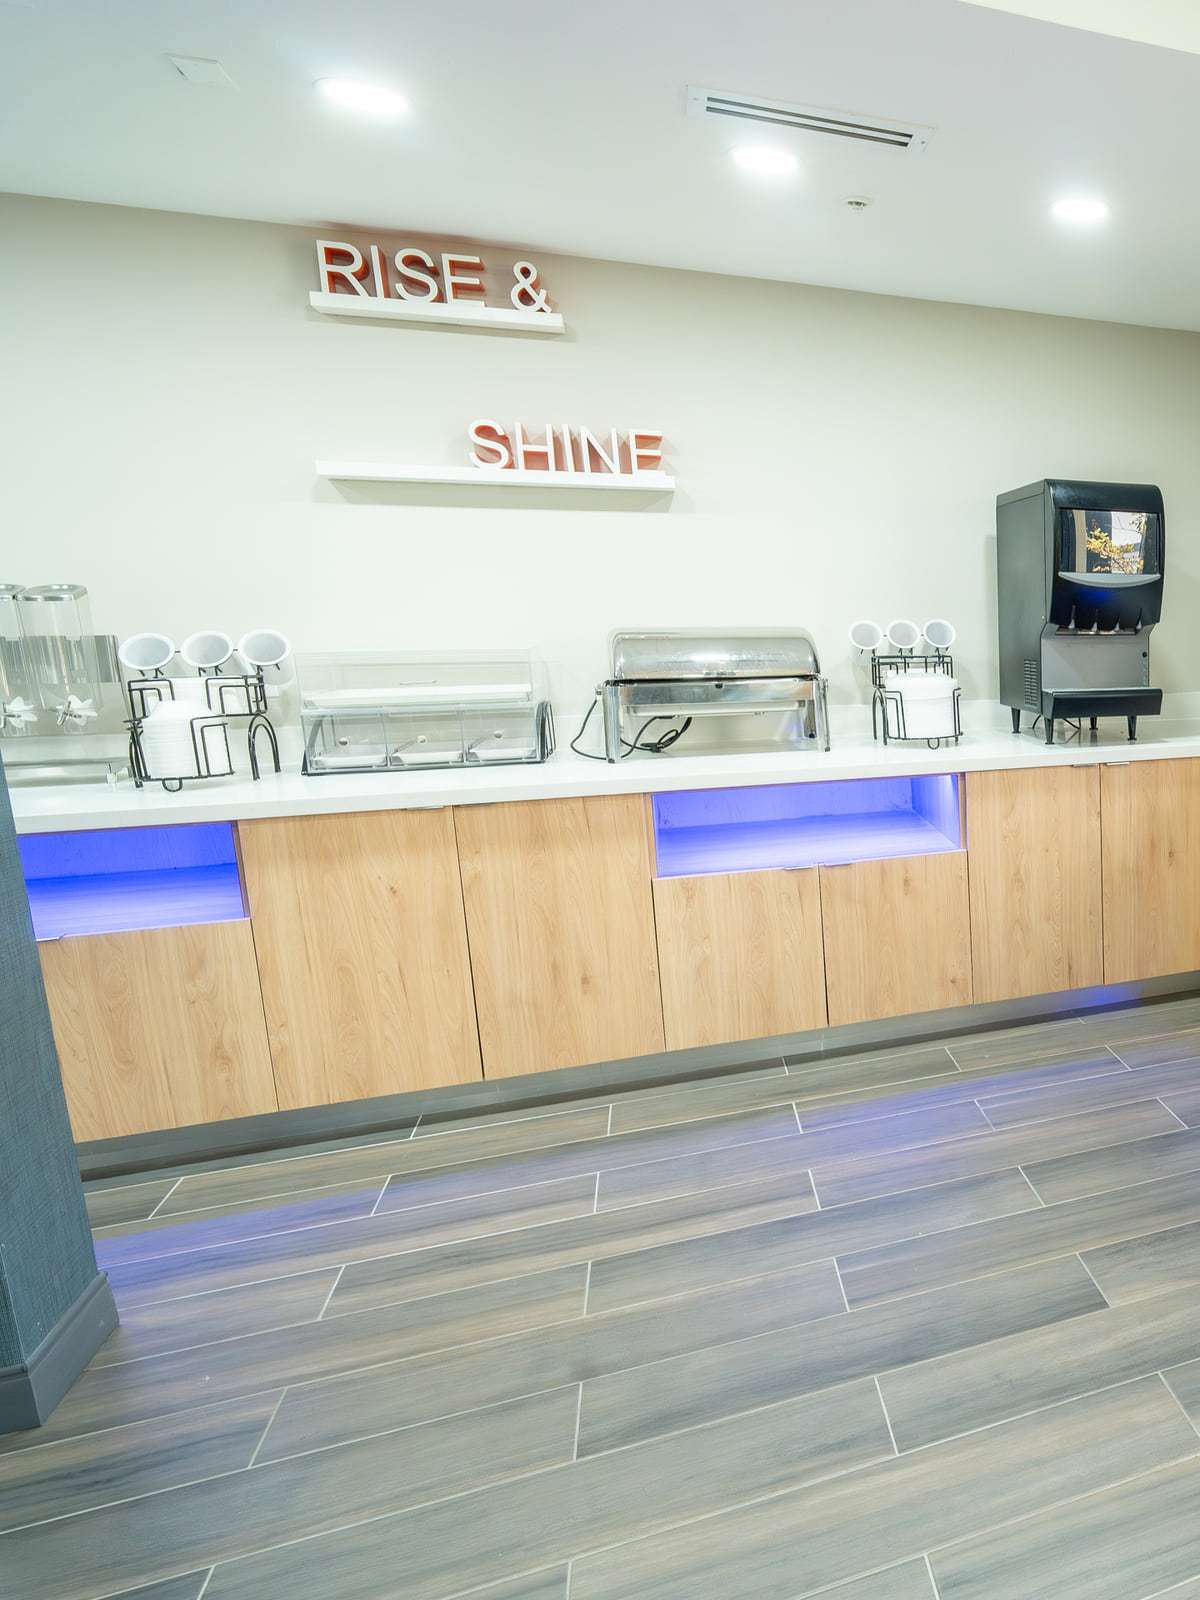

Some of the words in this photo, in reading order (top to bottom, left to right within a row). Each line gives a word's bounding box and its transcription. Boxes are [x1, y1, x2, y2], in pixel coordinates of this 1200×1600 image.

[316, 239, 487, 307] RISE
[511, 261, 552, 313] &
[468, 419, 665, 475] SHINE
